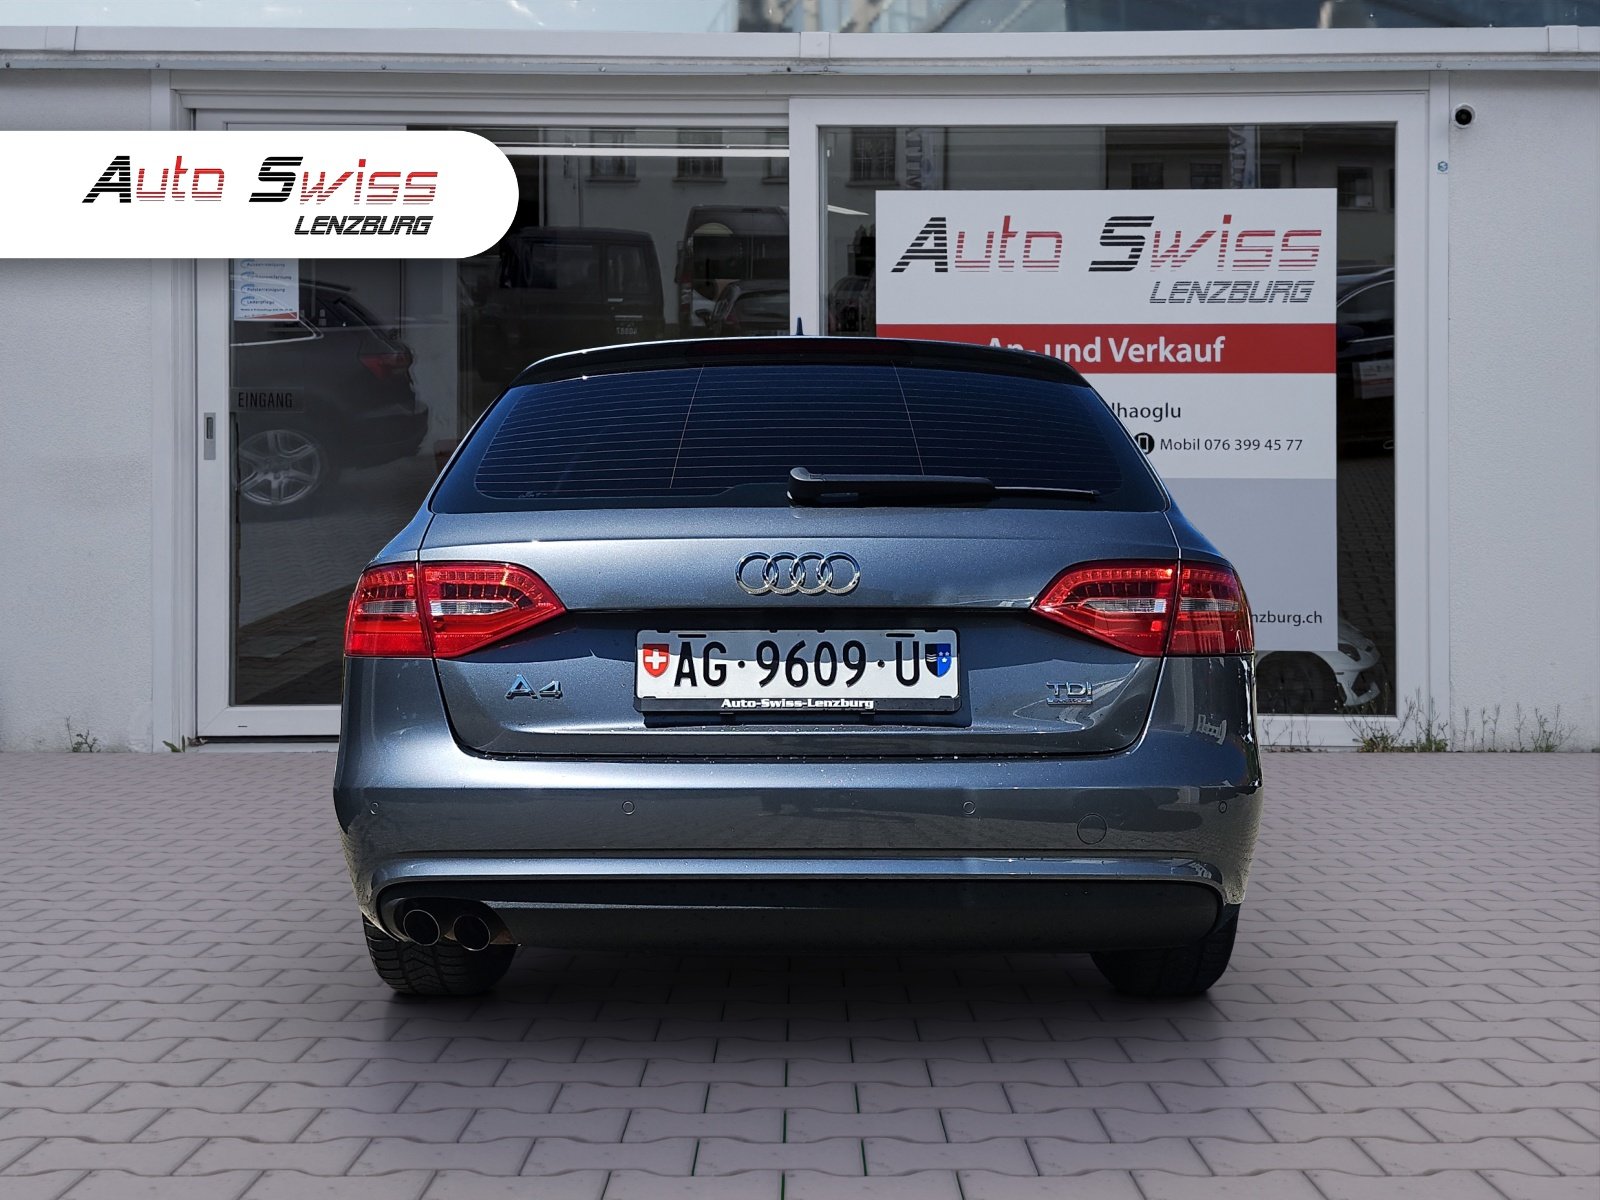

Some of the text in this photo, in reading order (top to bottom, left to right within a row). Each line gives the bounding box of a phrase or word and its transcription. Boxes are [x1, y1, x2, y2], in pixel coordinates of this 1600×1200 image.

[890, 213, 1323, 273] Auto Swiss
[1149, 280, 1316, 304] LENZBURG
[1044, 337, 1101, 363] und
[1108, 336, 1226, 363] Verkauf
[238, 392, 293, 408] EINGANG
[1159, 438, 1303, 451] Mobil 076 399 45 77
[504, 674, 564, 701] A4
[1046, 681, 1093, 697] TDI
